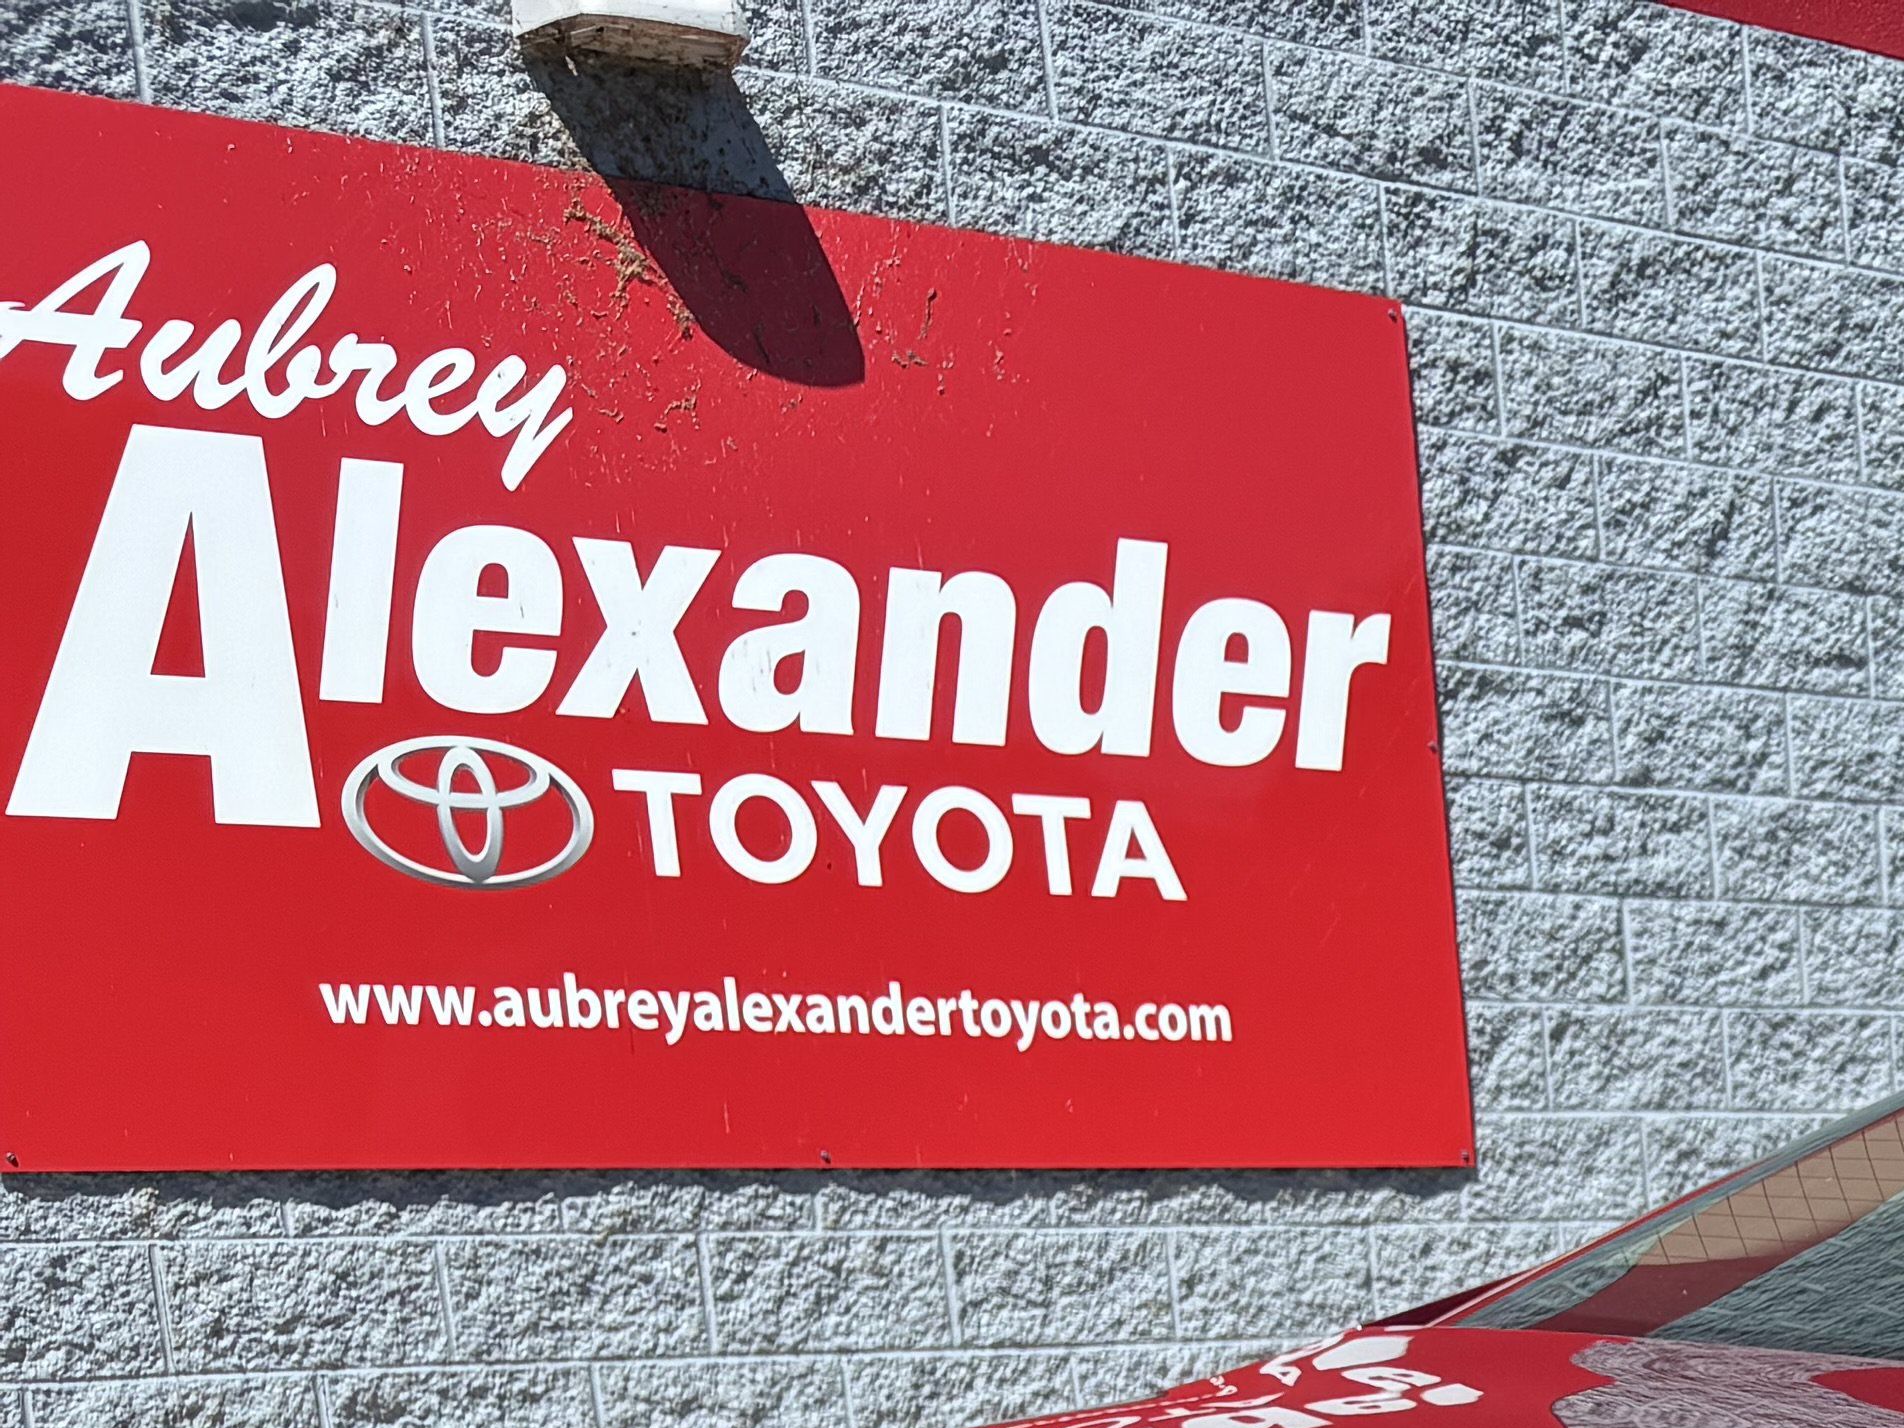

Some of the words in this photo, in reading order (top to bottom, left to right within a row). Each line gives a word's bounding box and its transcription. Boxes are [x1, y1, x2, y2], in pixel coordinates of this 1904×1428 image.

[0, 239, 573, 491] Aubrey
[10, 423, 1391, 829] Alexander
[611, 768, 1186, 900] TOYOTA
[319, 973, 1233, 1051] www.aubreyalexandertoyota.com
